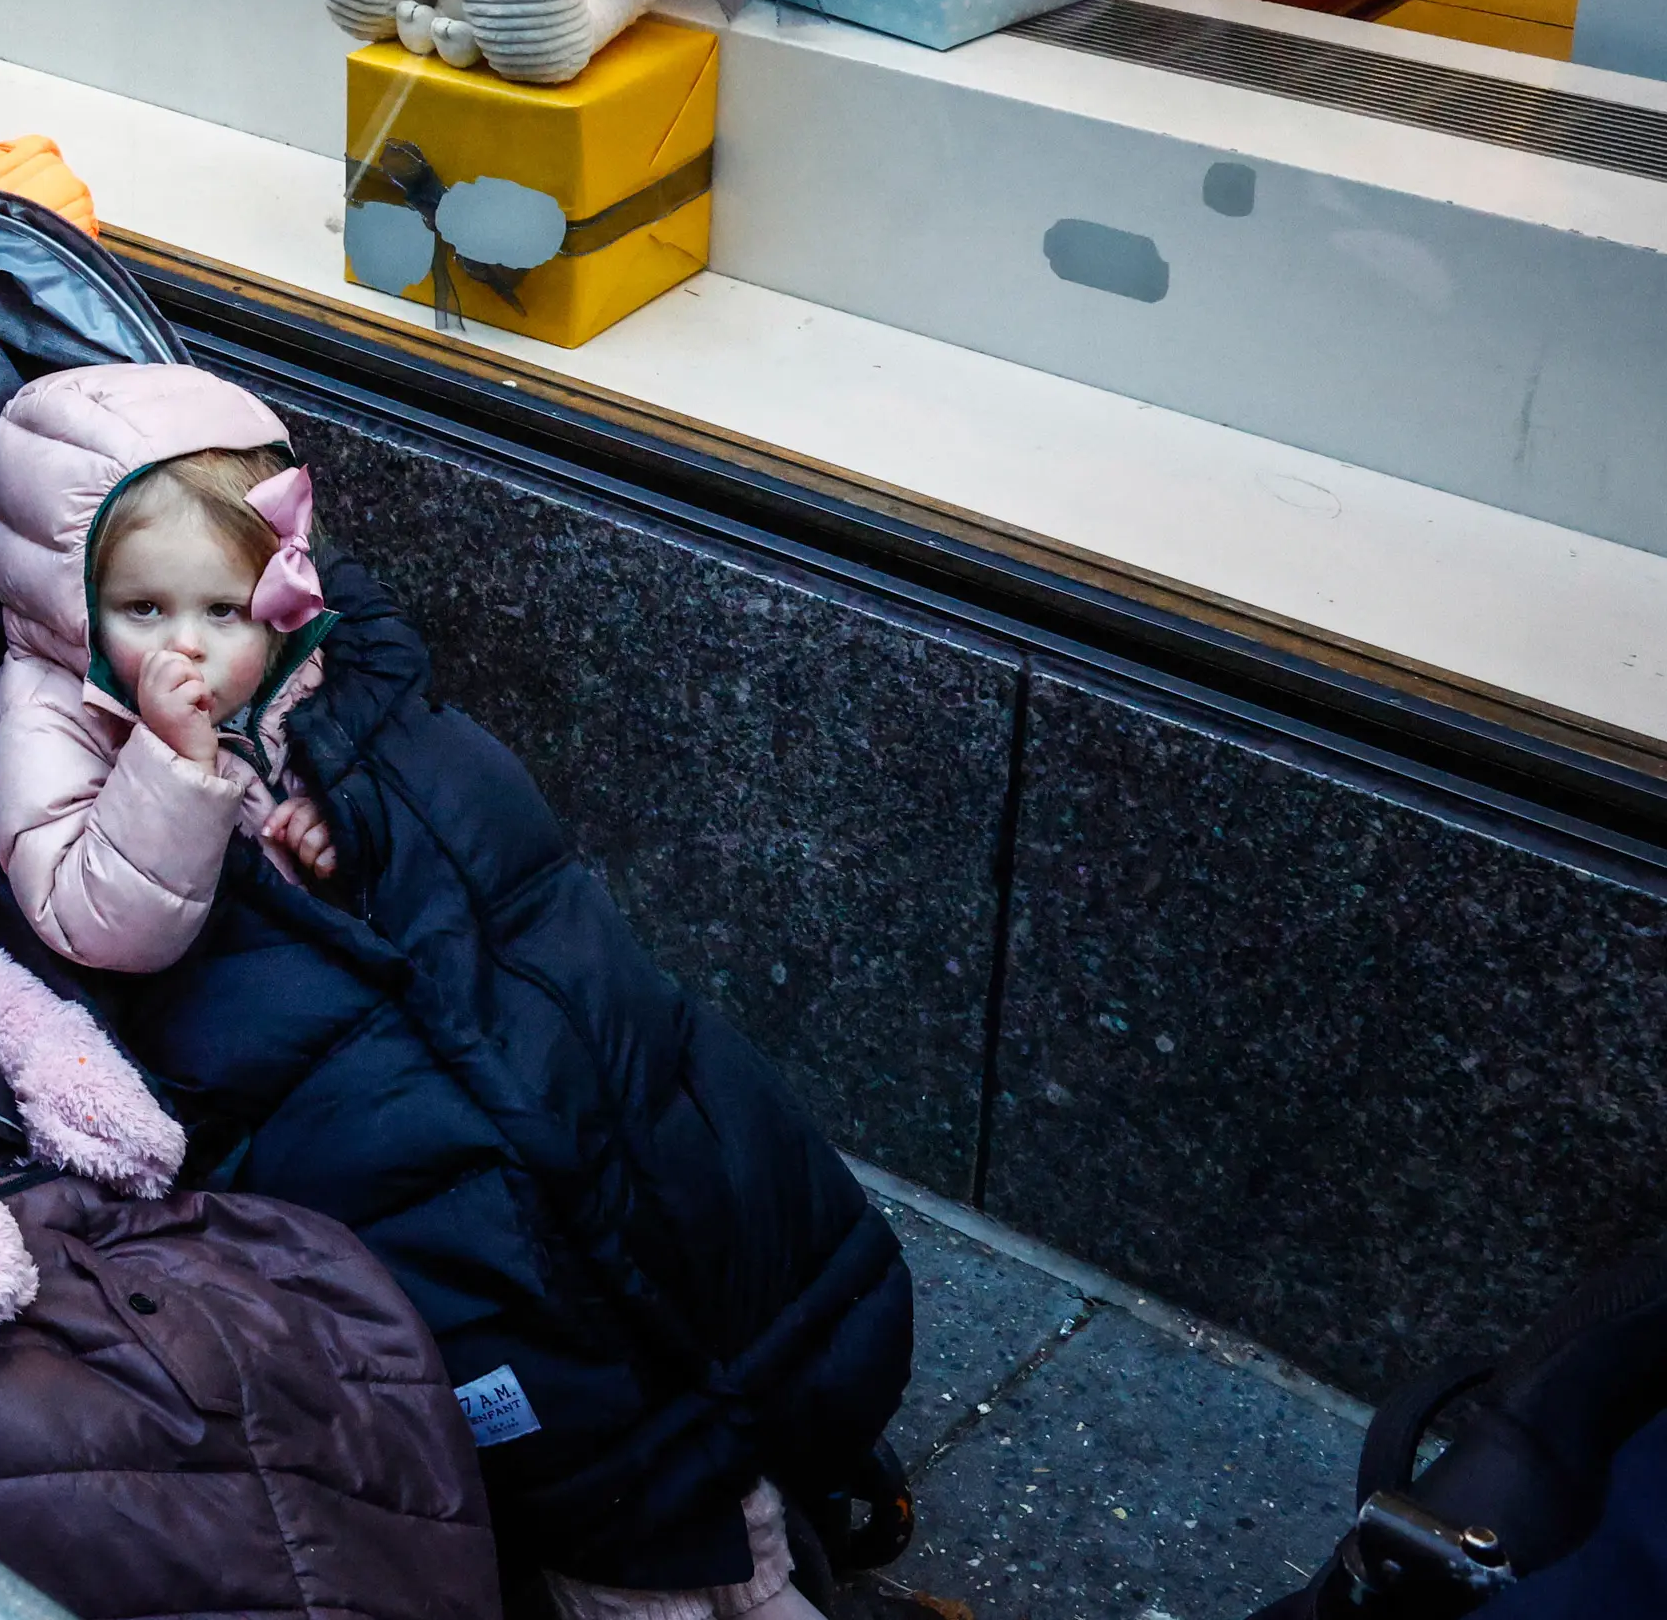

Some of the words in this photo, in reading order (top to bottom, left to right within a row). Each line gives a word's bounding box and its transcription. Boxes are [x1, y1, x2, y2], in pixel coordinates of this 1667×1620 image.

[459, 1396, 471, 1415] 7
[479, 1384, 516, 1409] A.M.
[469, 1399, 522, 1426] ENFANT
